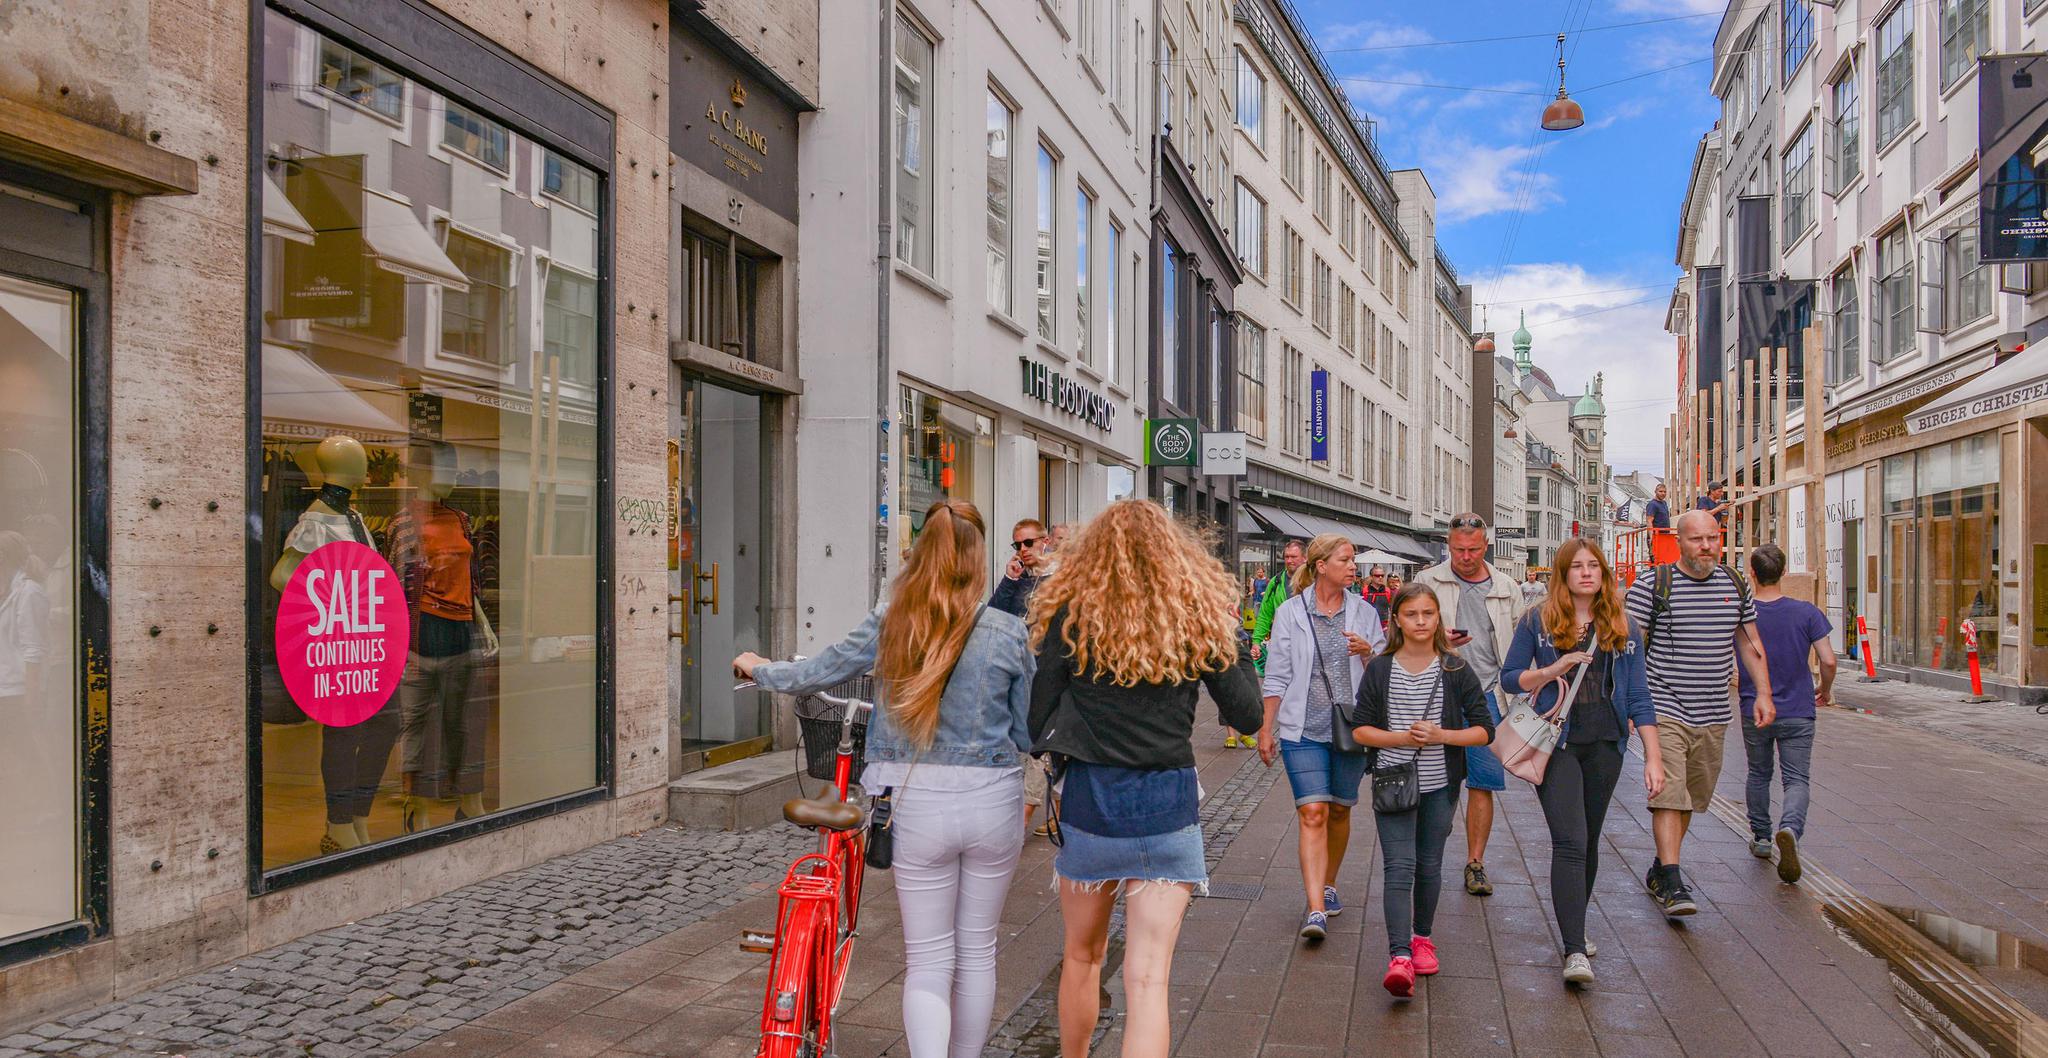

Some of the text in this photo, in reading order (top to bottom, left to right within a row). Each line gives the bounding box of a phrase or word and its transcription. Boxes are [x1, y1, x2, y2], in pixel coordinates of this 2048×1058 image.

[734, 117, 768, 156] BANG
[728, 196, 745, 225] 27
[1020, 356, 1117, 432] THE BODY SHOP
[1865, 370, 1957, 413] BIRGER CHRISTENSEN
[1315, 389, 1323, 436] ELGIGANTEN
[1918, 406, 1967, 431] BIRGER
[1207, 447, 1242, 460] COS
[1826, 439, 1855, 458] BIRGER
[1621, 505, 1629, 520] HAY
[1838, 499, 1856, 520] SALE
[306, 568, 385, 636] SALE
[306, 638, 386, 668] CONTINUES
[314, 668, 379, 698] IN-STORE
